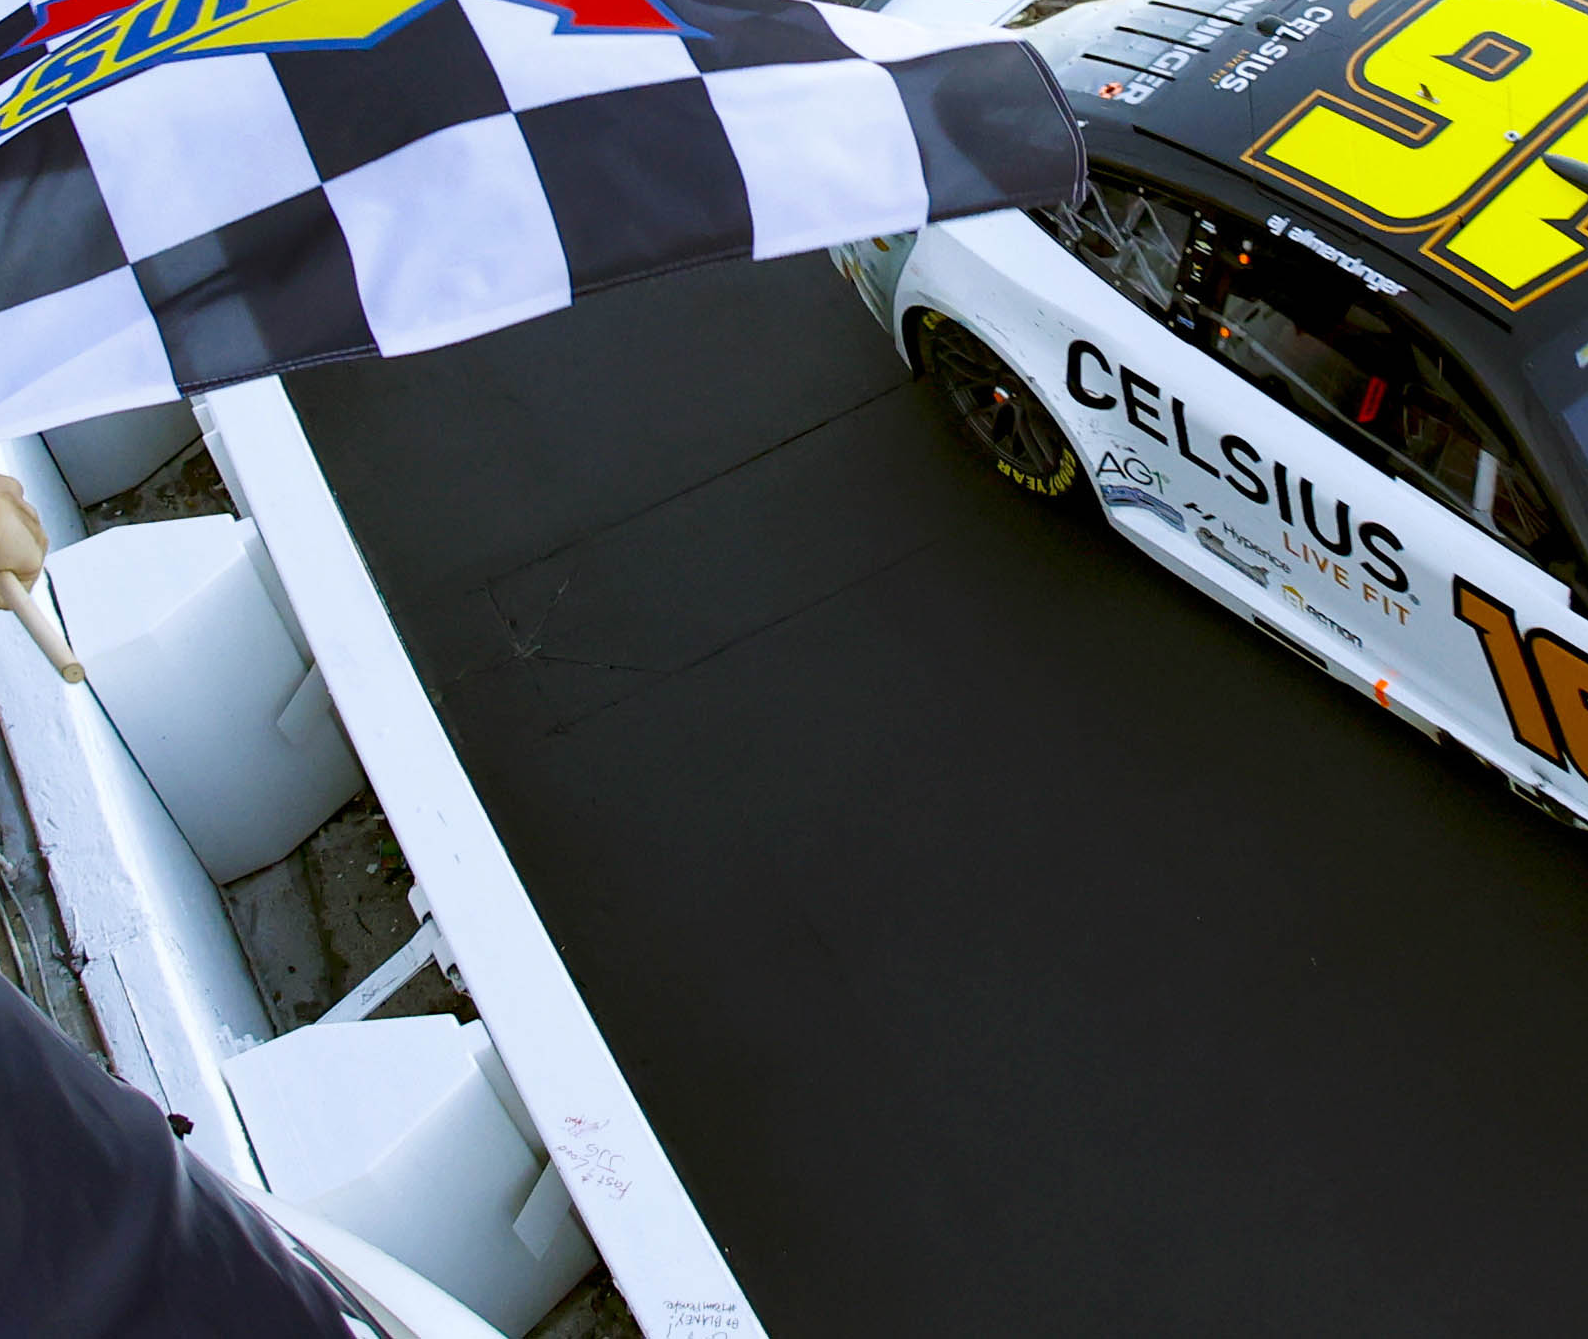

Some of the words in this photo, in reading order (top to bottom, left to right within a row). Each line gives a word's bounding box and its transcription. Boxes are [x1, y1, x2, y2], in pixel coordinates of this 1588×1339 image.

[1216, 6, 1334, 94] CELSIUS
[1265, 213, 1292, 237] aj
[1286, 225, 1409, 297] allmendinger
[1065, 339, 1411, 594] CELSIUS
[1095, 450, 1169, 495] AG1
[1282, 530, 1351, 591] LIVE
[1362, 581, 1413, 627] FIT
